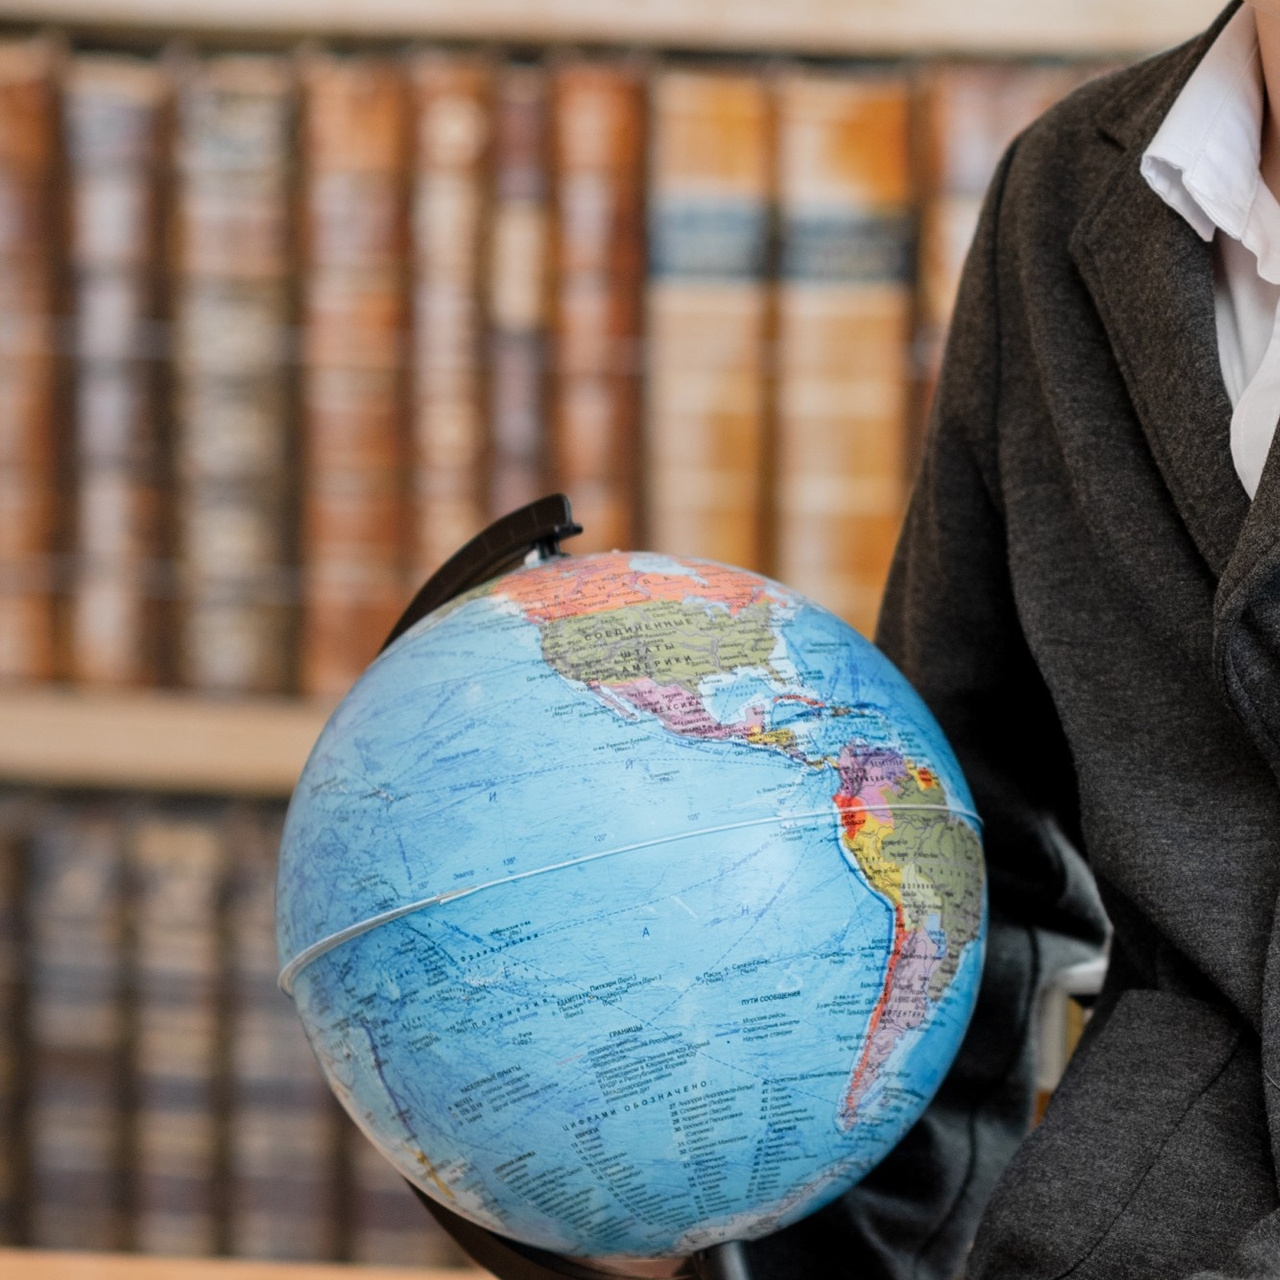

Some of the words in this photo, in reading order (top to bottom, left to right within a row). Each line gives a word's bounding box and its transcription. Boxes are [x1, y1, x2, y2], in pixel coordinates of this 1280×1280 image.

[584, 618, 693, 641] СОЕДИНЕННЫЕ
[620, 643, 675, 658] ШТАТЫ
[621, 655, 692, 674] АМЕРИКИ
[651, 700, 701, 713] МЕКСИКА
[741, 996, 759, 1006] ПУТИ
[759, 990, 801, 1003] СООБЩЕНИЯ
[608, 1024, 643, 1038] ГРАНИЦЫ
[562, 1109, 617, 1132] ЦИФРАМИ
